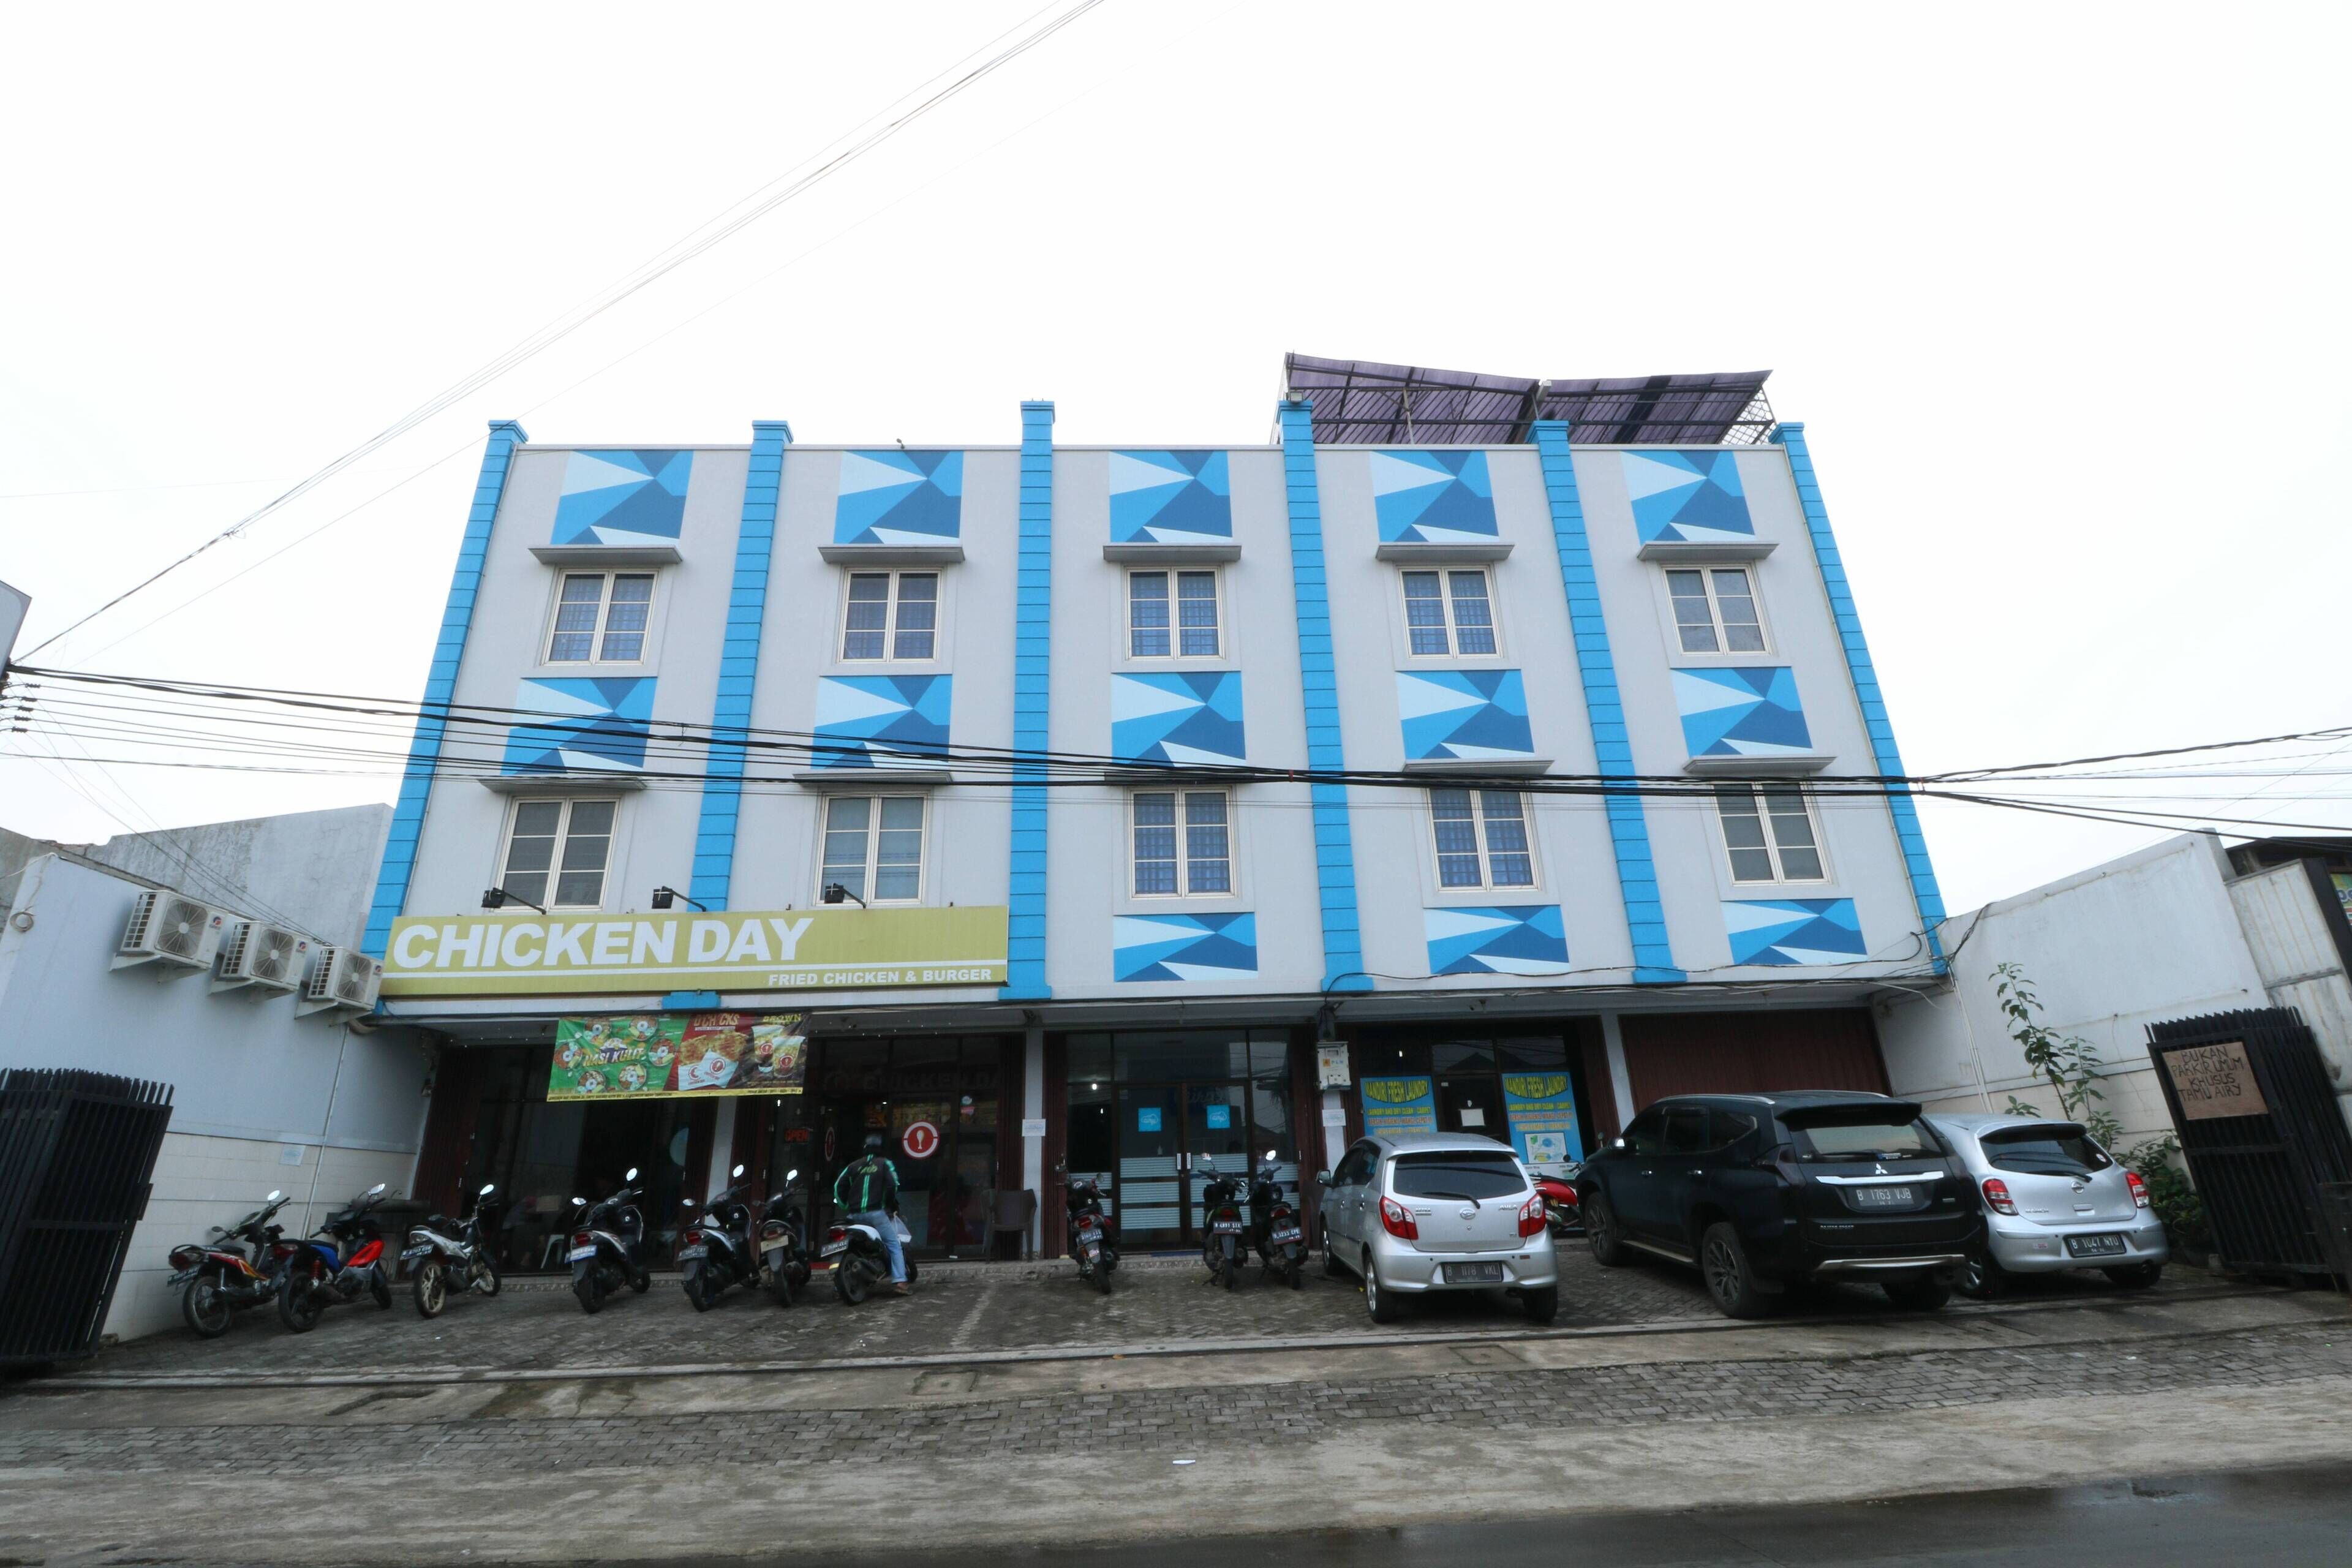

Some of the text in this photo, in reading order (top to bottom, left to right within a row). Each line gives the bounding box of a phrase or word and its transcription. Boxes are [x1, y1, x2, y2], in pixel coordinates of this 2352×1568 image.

[394, 918, 814, 969] CHICKEN DAY
[769, 968, 992, 986] FRIED CHICKEN & BURGER
[582, 1048, 644, 1067] NASI KULIT
[2181, 1046, 2229, 1064] BUKAN
[2171, 1056, 2244, 1077] PARKIR UMUM
[2188, 1072, 2236, 1088] KHUSUS
[2177, 1084, 2242, 1101] TAMU AIRY
[785, 1129, 809, 1143] OPEN
[1856, 1187, 1912, 1201] B 1763 VJB
[2070, 1238, 2078, 1250] B
[1447, 1264, 1499, 1276] B 1178 VKL
